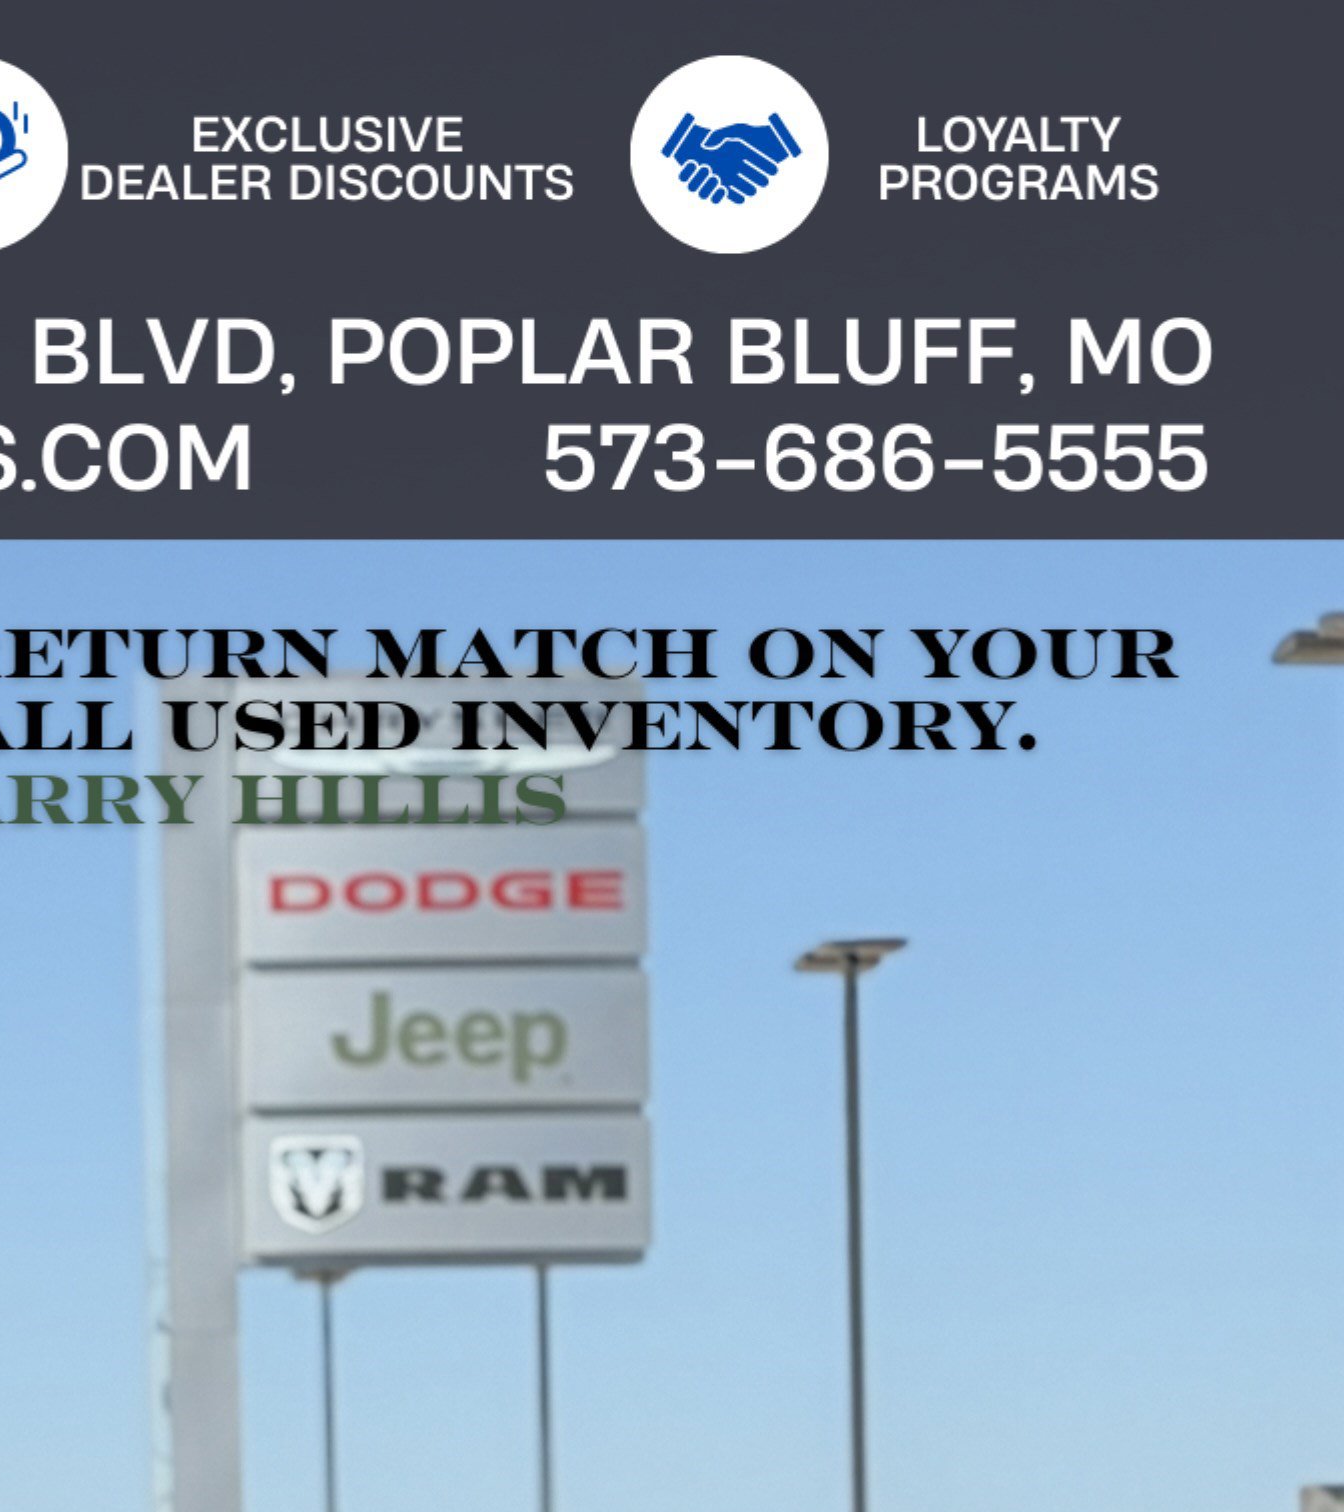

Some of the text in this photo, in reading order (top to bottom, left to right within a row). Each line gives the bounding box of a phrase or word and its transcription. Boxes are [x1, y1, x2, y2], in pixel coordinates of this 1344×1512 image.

[269, 870, 624, 914] DODGE
[331, 990, 568, 1083] Jeep
[381, 1165, 627, 1202] RAM
